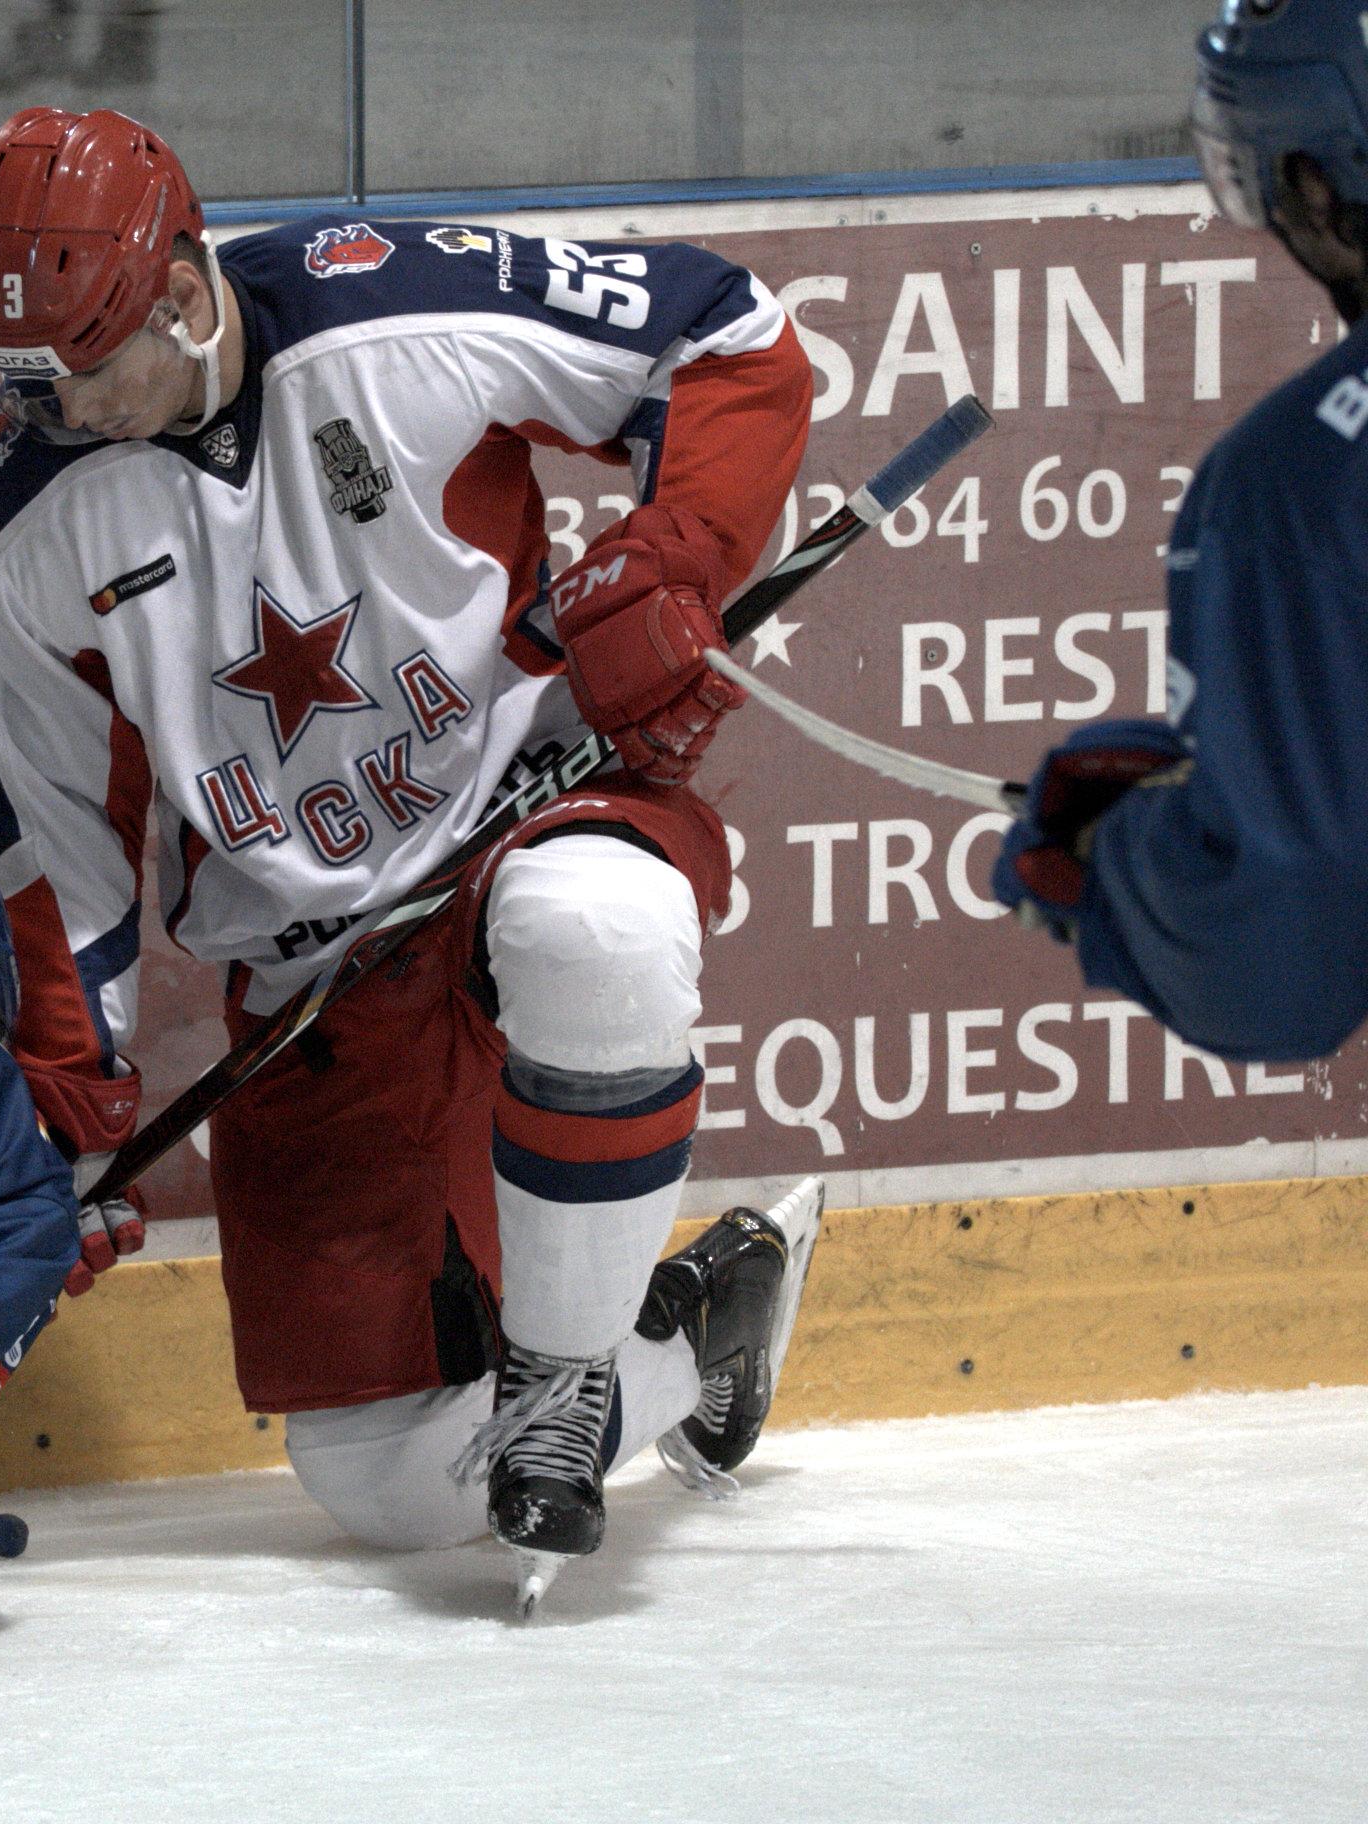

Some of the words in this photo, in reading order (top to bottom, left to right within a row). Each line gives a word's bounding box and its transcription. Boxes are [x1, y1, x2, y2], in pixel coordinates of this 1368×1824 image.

[544, 237, 650, 330] 53
[790, 258, 1256, 423] SAINT
[331, 467, 393, 515] ФИНАЛ
[1020, 455, 1127, 542] 60
[118, 559, 174, 593] mastercard
[901, 610, 1169, 727] REST
[194, 647, 474, 868] ЦСКА
